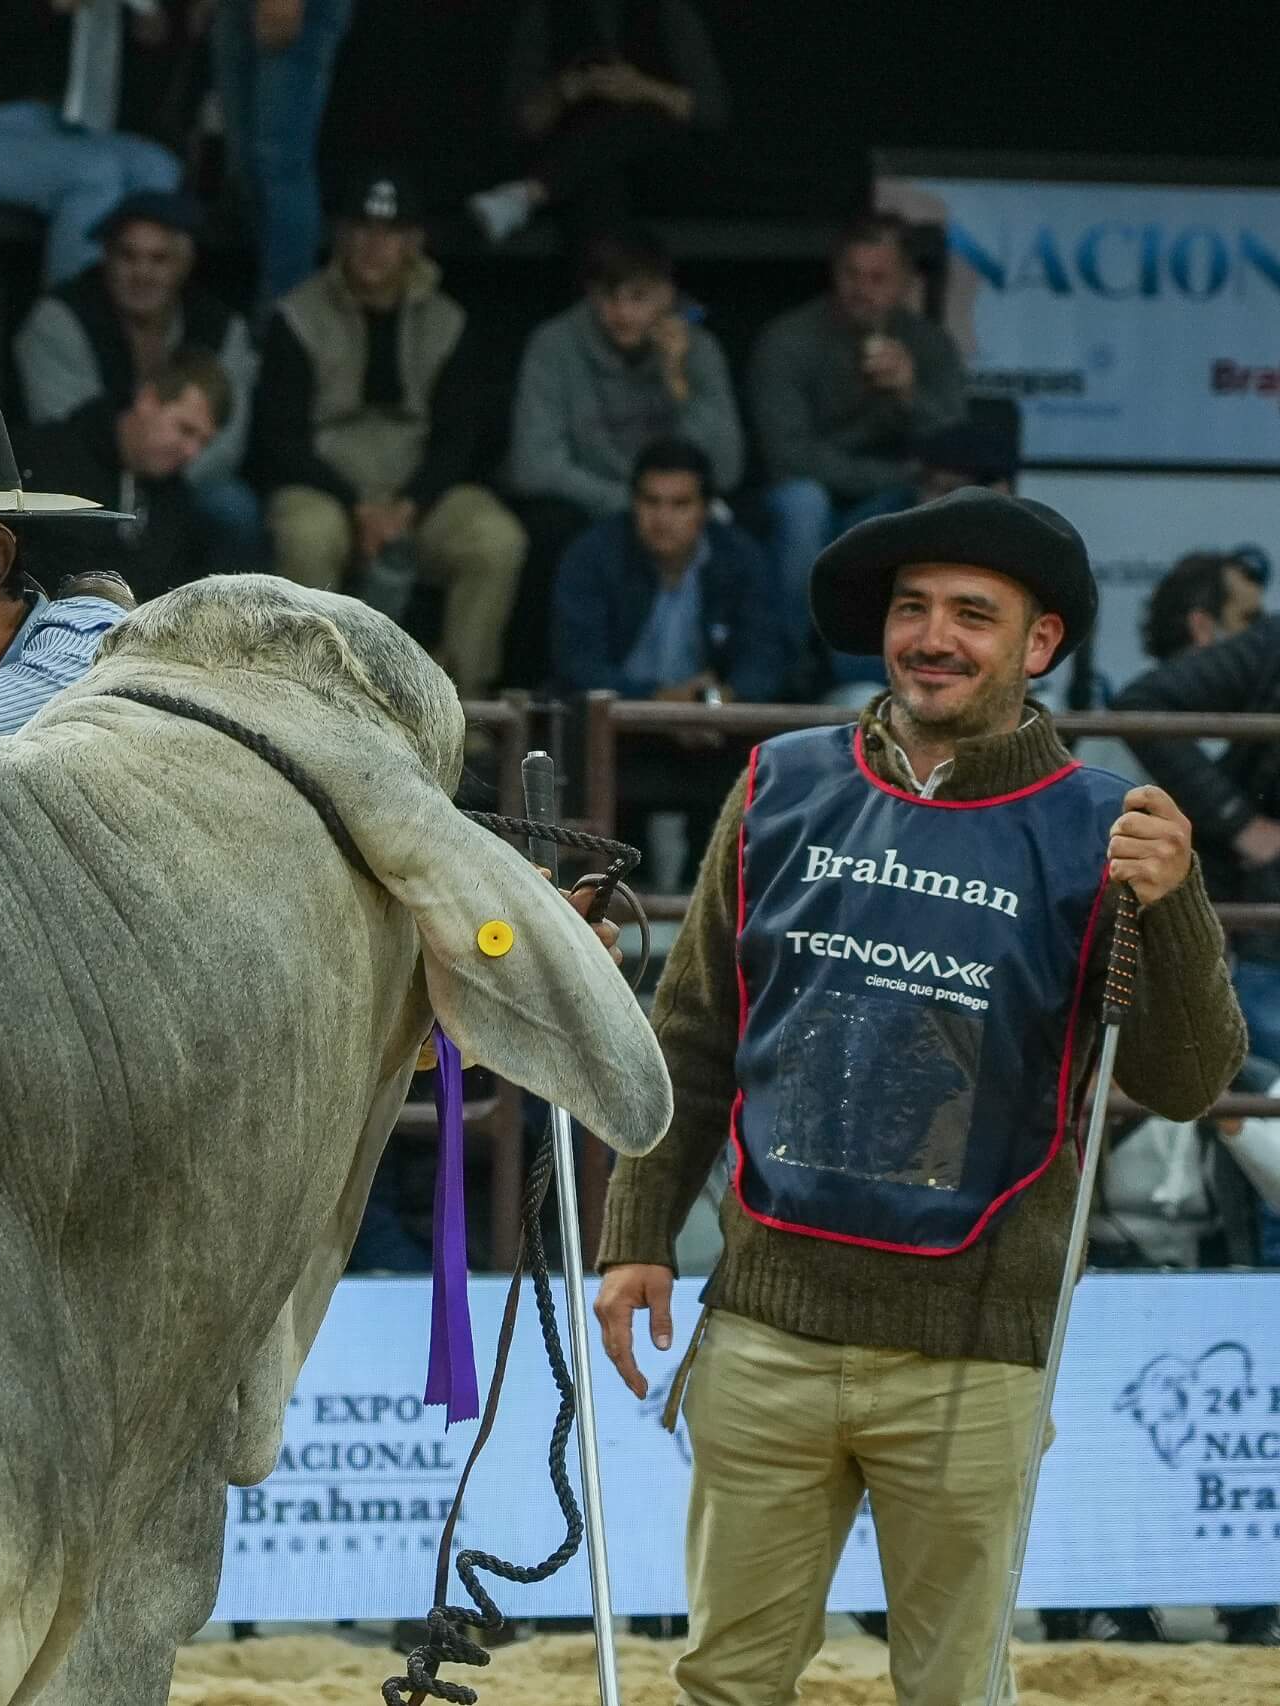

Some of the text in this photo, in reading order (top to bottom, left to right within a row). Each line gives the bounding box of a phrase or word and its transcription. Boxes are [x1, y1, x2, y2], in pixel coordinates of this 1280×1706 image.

[801, 845, 1019, 917] Brahman
[785, 931, 993, 989] TECNOVAX
[865, 974, 989, 1010] ciencia que protege
[314, 1393, 424, 1424] EXPO
[277, 1440, 454, 1472] ACIONAL
[237, 1487, 466, 1524] Brahman
